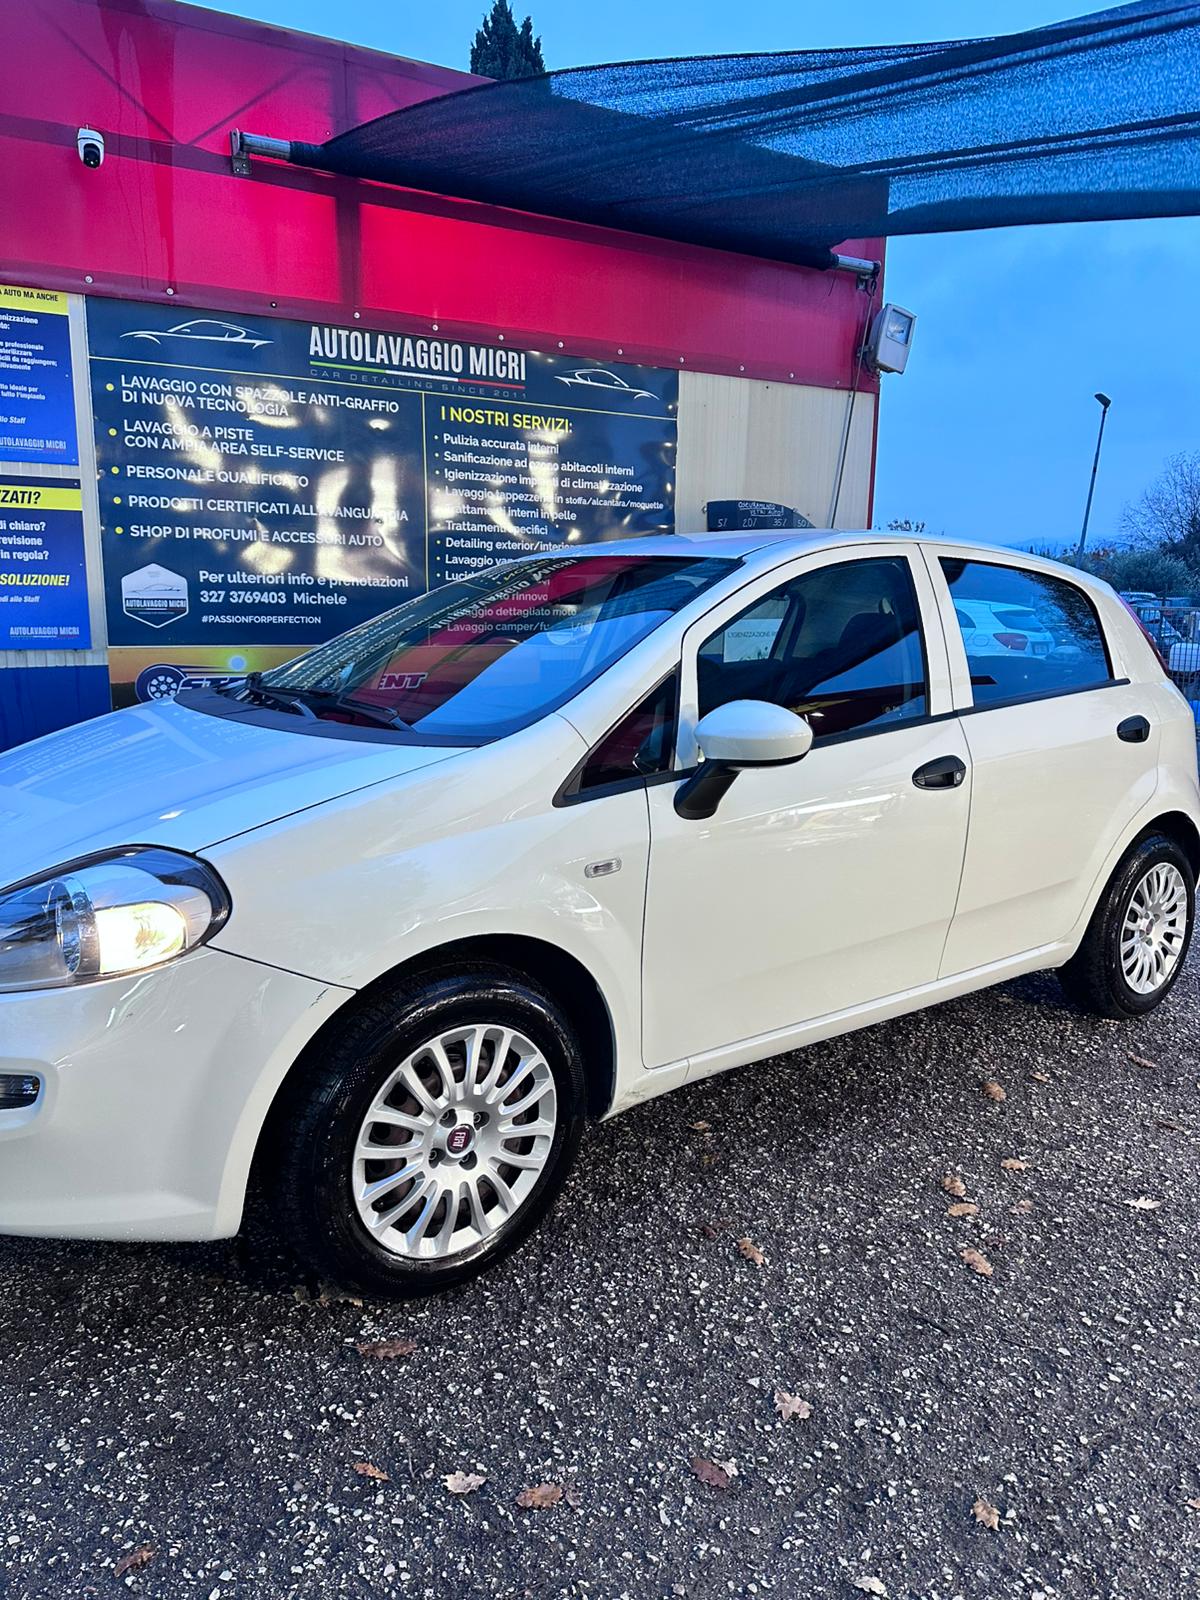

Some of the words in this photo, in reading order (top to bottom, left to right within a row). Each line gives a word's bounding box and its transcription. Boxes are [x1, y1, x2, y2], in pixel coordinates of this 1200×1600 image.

[4, 288, 22, 297] AUTO
[24, 291, 34, 299] MA
[36, 292, 58, 302] ANCHE
[5, 342, 44, 350] professionale
[309, 326, 462, 374] AUTOLAVAGGIO
[470, 346, 526, 380] MICRI
[20, 358, 58, 367] raggiungere;
[10, 384, 27, 392] ideale
[310, 369, 340, 378] CAR
[350, 374, 434, 389] DETAILING
[442, 383, 486, 394] SINCE
[494, 389, 527, 400] 2011
[16, 392, 46, 400] l'impianto
[121, 375, 196, 394] LAVAGGIO
[200, 383, 232, 396] CON
[235, 386, 306, 404] SPAZZOLE
[309, 393, 399, 413] ANTI-GRAFFIO
[122, 390, 138, 403] DI
[142, 392, 195, 408] NUOVA
[197, 397, 288, 416] TECNOLOGIA
[9, 416, 26, 424] Staff
[440, 406, 446, 420] I
[450, 407, 509, 426] NOSTRI
[513, 414, 573, 434] SERVIZI:
[124, 419, 199, 436] LAVAGGIO
[202, 426, 212, 438] A
[214, 427, 254, 441] PISTE
[46, 440, 66, 450] MICRI
[124, 435, 158, 449] CON
[162, 438, 207, 452] AMPIA
[211, 442, 248, 456] AREA
[250, 444, 344, 462] SELF-SERVICE
[443, 433, 480, 446] Pulizia
[481, 438, 526, 451] accurata
[527, 441, 560, 454] interni
[444, 452, 513, 467] Sanificazione
[514, 458, 528, 468] ad
[560, 462, 604, 473] abitacoli
[605, 464, 634, 476] interni
[126, 465, 215, 482] PERSONALE
[218, 471, 309, 488] QUALIFICATO
[444, 468, 518, 484] Igienizzazione
[560, 478, 570, 488] di
[128, 495, 204, 511] PRODOTTI
[206, 500, 290, 515] CERTIFICATI
[445, 486, 494, 501] Lavaggio
[555, 495, 564, 504] in
[565, 496, 664, 511] stoffa/alcantara/moquette
[508, 507, 540, 519] interni
[540, 509, 550, 520] in
[552, 511, 577, 522] pelle
[9, 521, 46, 531] chiaro?
[130, 525, 172, 538] SHOP
[174, 526, 190, 539] DI
[193, 528, 257, 542] PROFUMI
[261, 530, 270, 542] E
[272, 532, 346, 545] ACCESSORI
[348, 534, 383, 547] AUTO
[446, 537, 494, 552] Detailing
[0, 550, 10, 559] in
[12, 550, 49, 562] regola?
[445, 554, 494, 567] Lavaggio
[0, 574, 70, 586] SOLUZIONE!
[198, 570, 224, 583] Per
[227, 571, 284, 585] ulteriori
[287, 573, 314, 586] info
[318, 576, 326, 586] e
[329, 576, 408, 588] prenotazioni
[126, 600, 168, 608] AUTOLAVAGGIO
[200, 590, 226, 603] 327
[229, 591, 286, 604] 3769403
[294, 592, 348, 605] Michele
[202, 615, 322, 624] #PASSIONFORPERFECTION
[496, 607, 551, 619] dettagliato
[552, 608, 577, 616] moto
[10, 626, 58, 635] AUTOLAVAGGIO
[60, 627, 80, 636] MICRI
[447, 622, 494, 632] Lavaggio
[452, 1132, 467, 1148] FIAT
